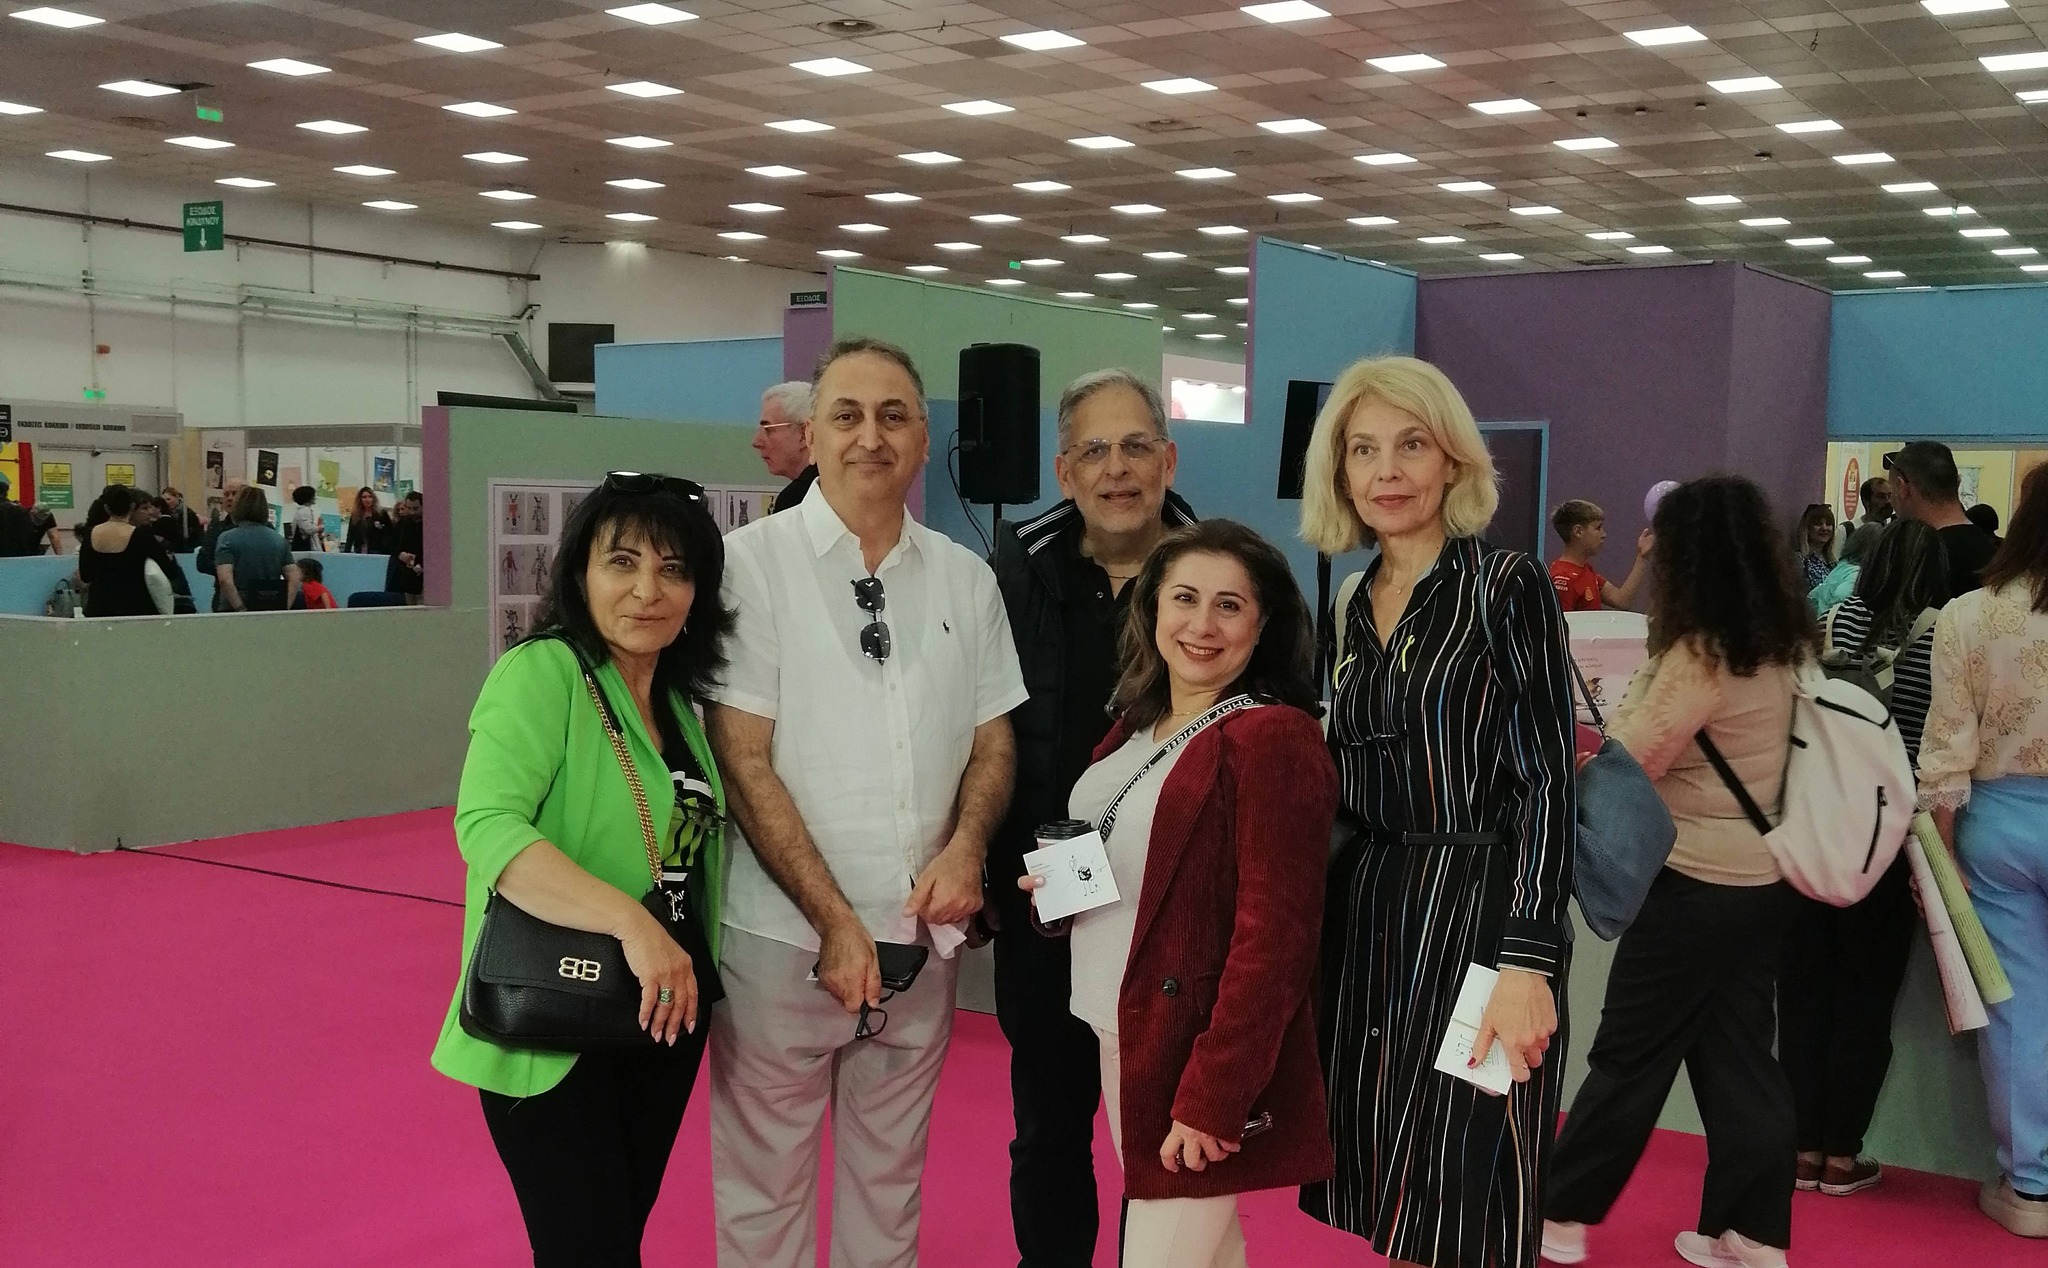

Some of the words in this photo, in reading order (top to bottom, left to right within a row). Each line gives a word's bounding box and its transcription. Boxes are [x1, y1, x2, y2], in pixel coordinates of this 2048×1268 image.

[189, 206, 216, 215] ΕΞΟΔΟΣ
[187, 217, 219, 226] ΚΙΝΔΥΝΟΥ
[1216, 698, 1254, 716] OMMY
[1164, 716, 1210, 753] HILFIGER
